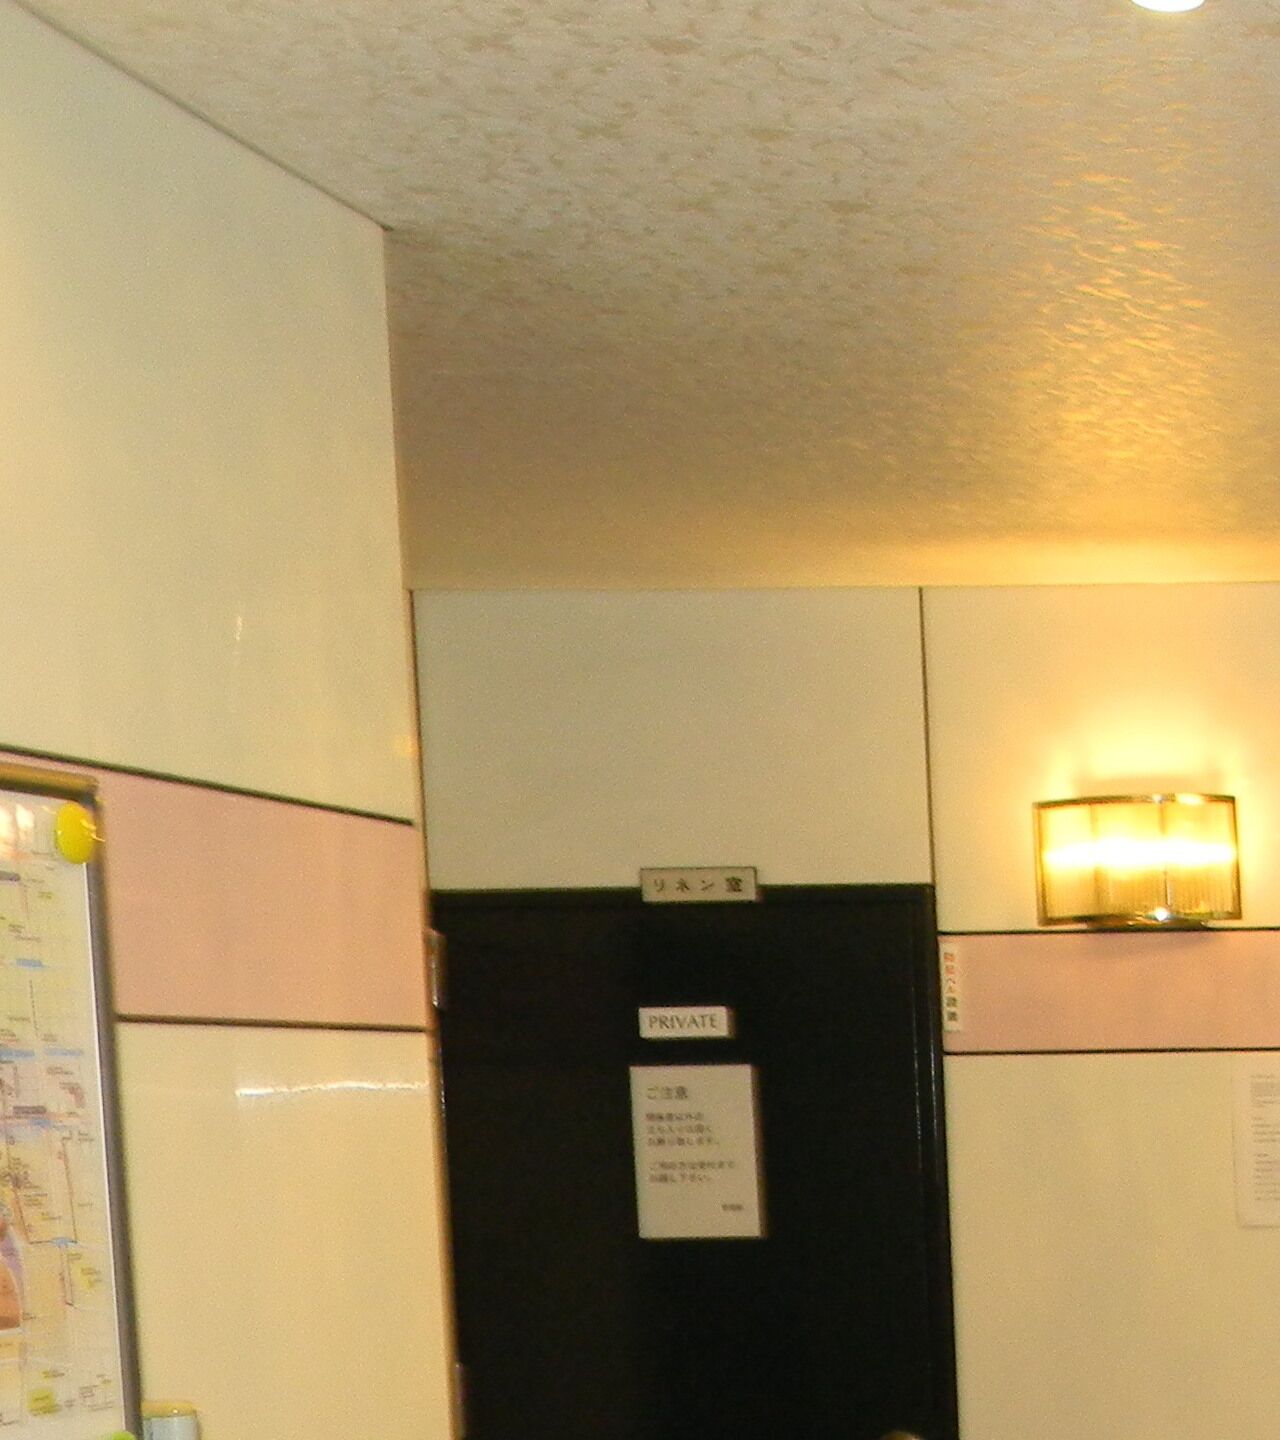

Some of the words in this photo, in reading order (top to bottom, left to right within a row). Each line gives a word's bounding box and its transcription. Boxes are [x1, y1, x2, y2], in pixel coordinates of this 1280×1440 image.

[653, 876, 743, 893] リネン室
[648, 1013, 718, 1030] PRIVATE
[646, 1085, 688, 1100] ご注意
